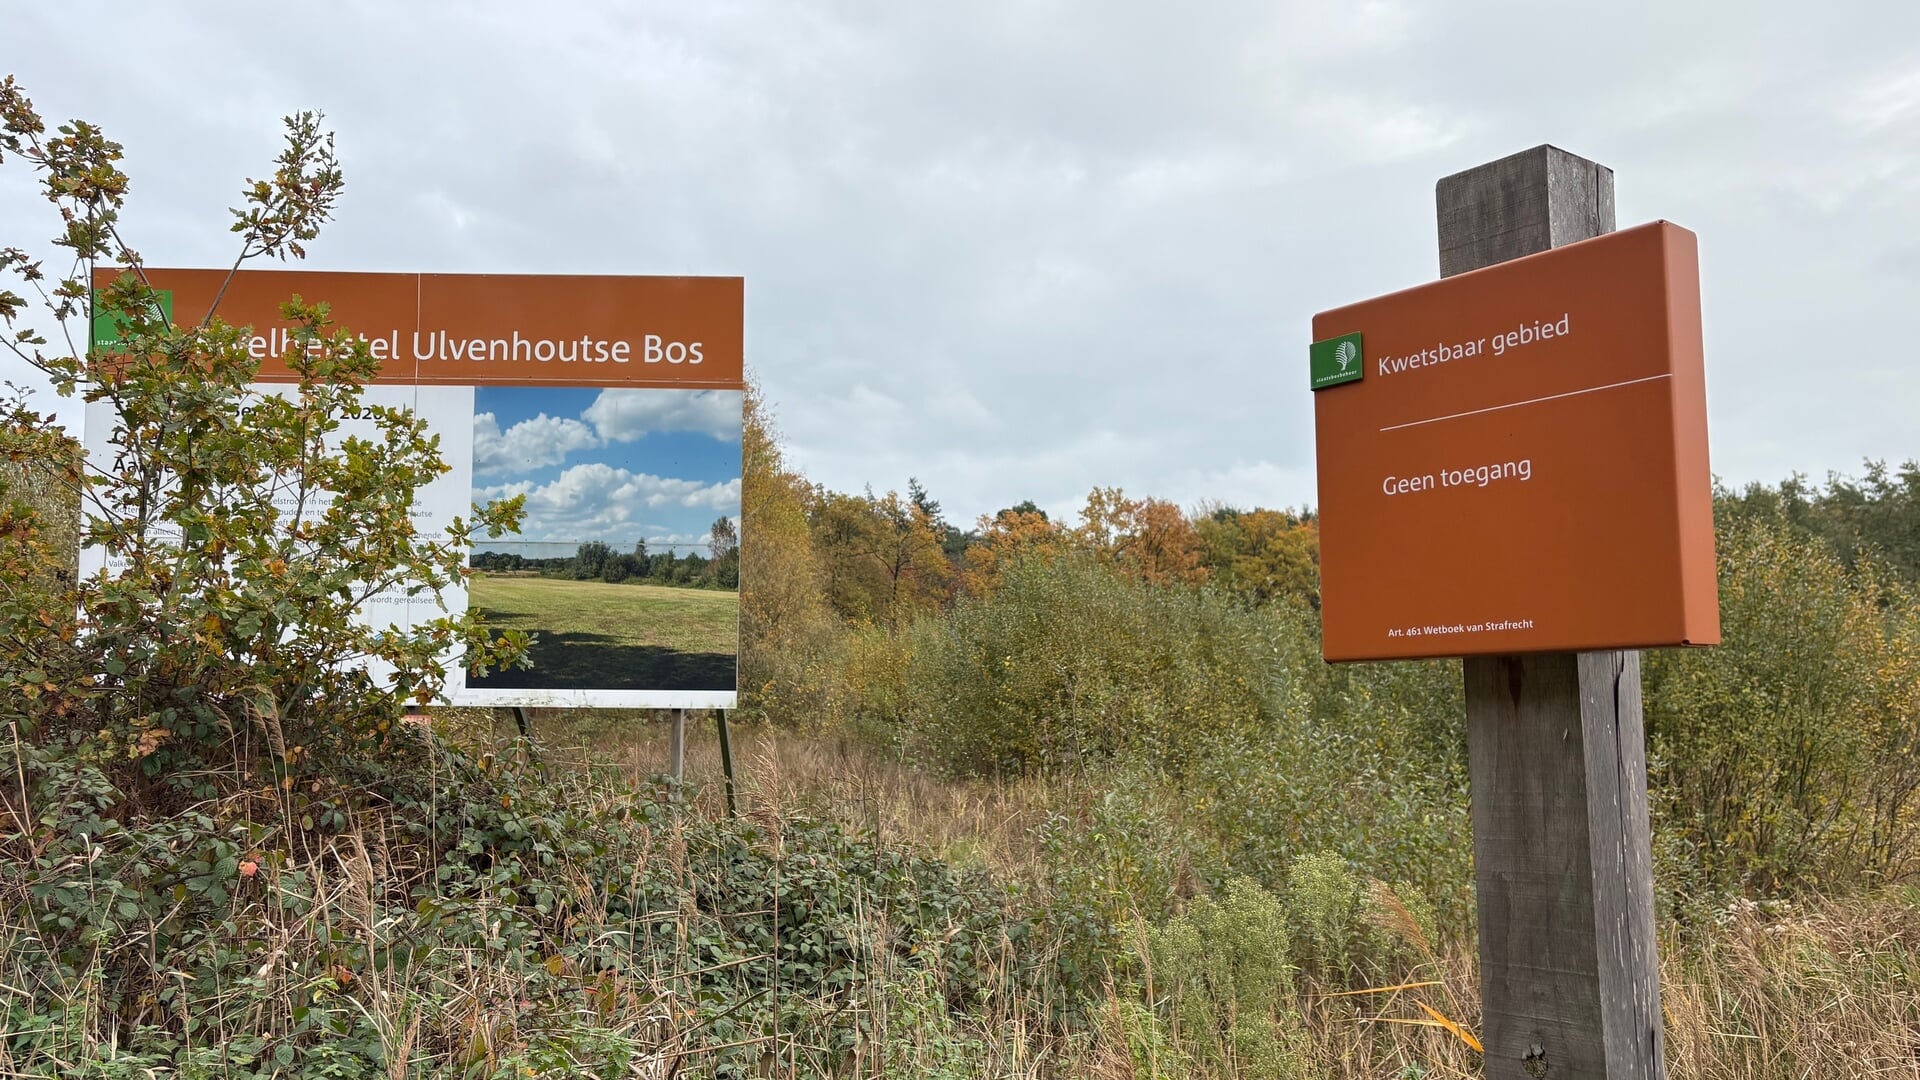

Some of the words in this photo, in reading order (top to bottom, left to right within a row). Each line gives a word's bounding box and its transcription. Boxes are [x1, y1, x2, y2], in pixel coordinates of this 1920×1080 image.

[412, 330, 630, 362] Ulvenhoutse
[644, 334, 704, 364] Bos
[1378, 338, 1485, 376] Kwetsbaar
[1491, 313, 1570, 355] gebied
[1383, 475, 1435, 495] Geen
[1441, 459, 1532, 487] toegang
[1388, 628, 1404, 637] Art.
[1406, 626, 1422, 636] 461
[1423, 624, 1464, 635] Wetboek
[1466, 624, 1483, 632] van
[1485, 619, 1533, 631] Strafrecht
